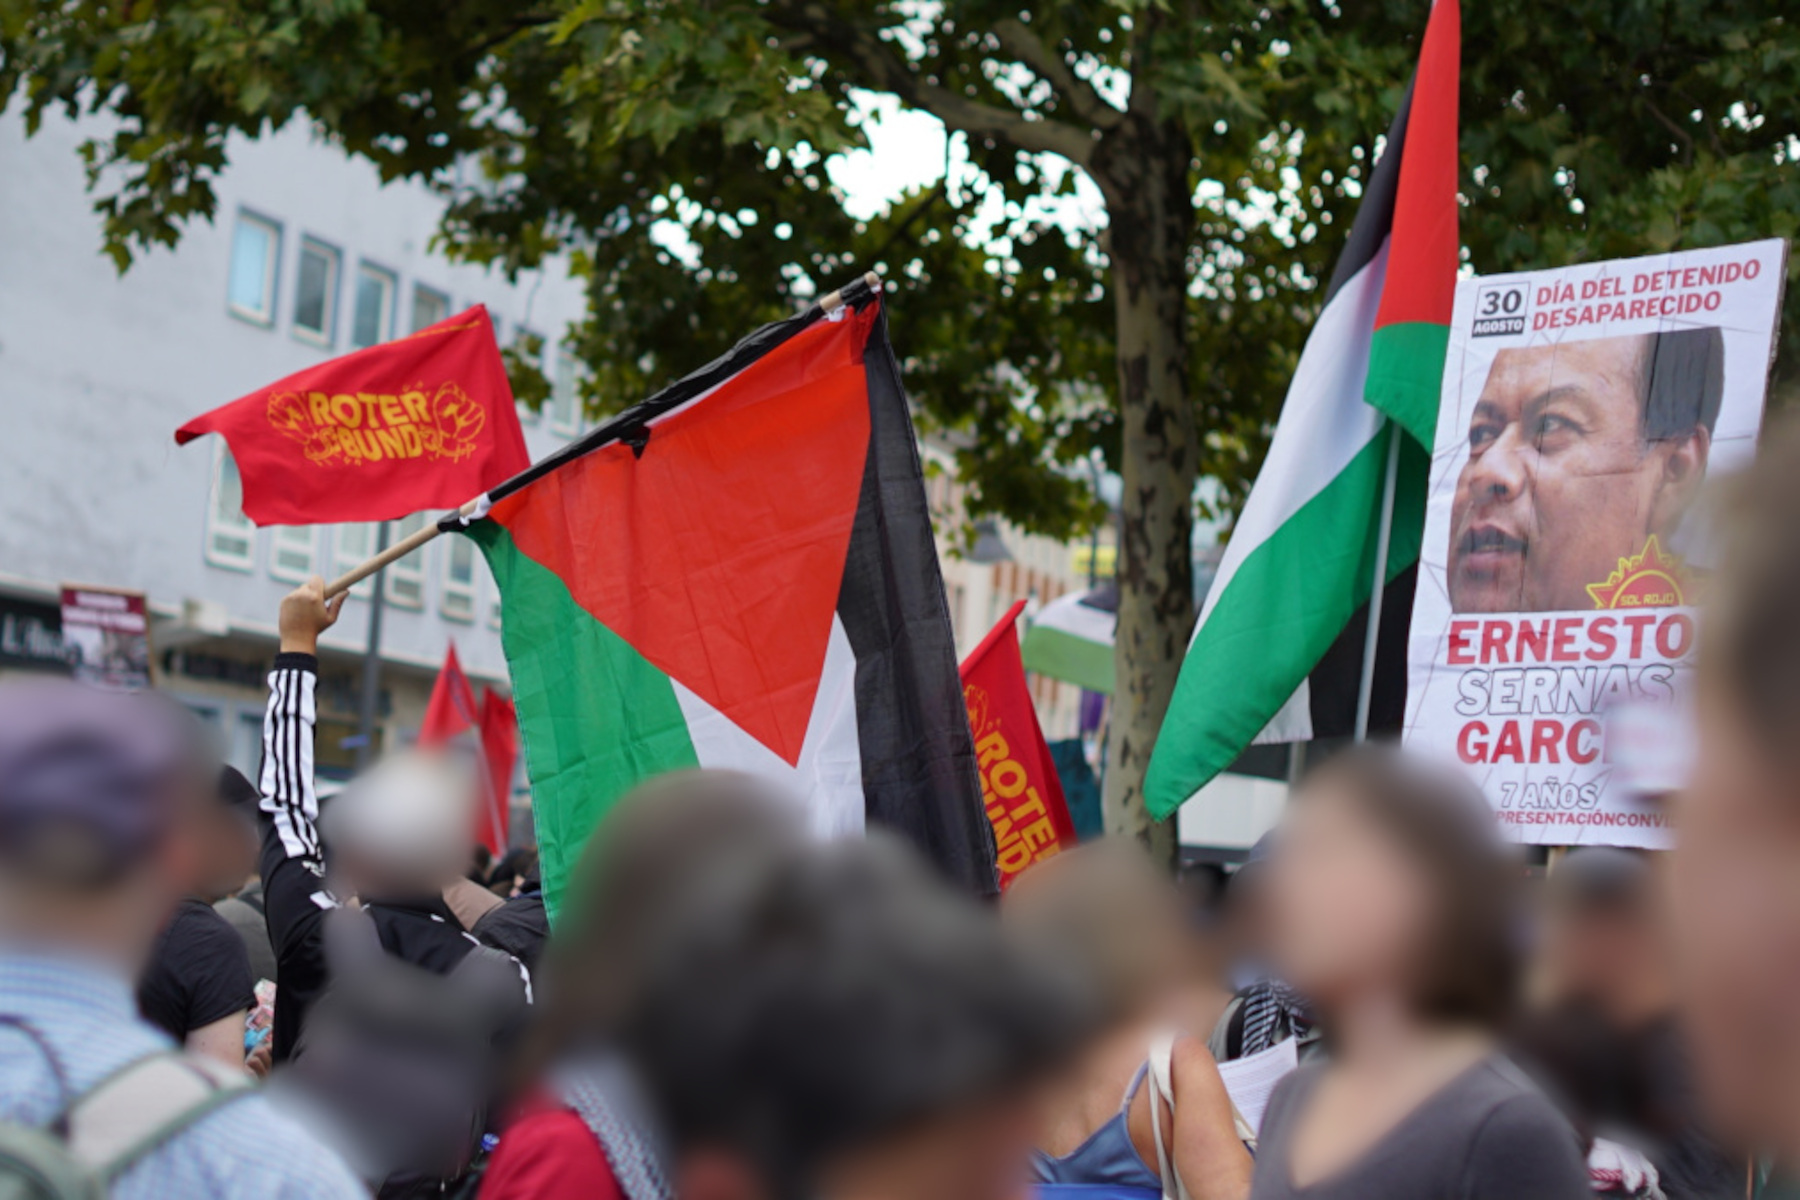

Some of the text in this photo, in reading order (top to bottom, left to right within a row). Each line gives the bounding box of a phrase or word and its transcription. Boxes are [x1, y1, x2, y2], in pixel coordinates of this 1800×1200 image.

[1536, 259, 1761, 306] DÍA DEL DETENIDO
[1481, 290, 1522, 315] 30
[1532, 291, 1722, 331] DESAPARECIDO
[1473, 318, 1524, 335] AGOSTO
[308, 390, 432, 429] ROTER
[1446, 613, 1695, 666] ERNESTO
[1454, 664, 1675, 716] SERNAS
[1456, 719, 1614, 765] GARC
[1501, 776, 1600, 810] 7 AÑOS
[1494, 809, 1679, 829] PRESENTACIÓNCONVI
